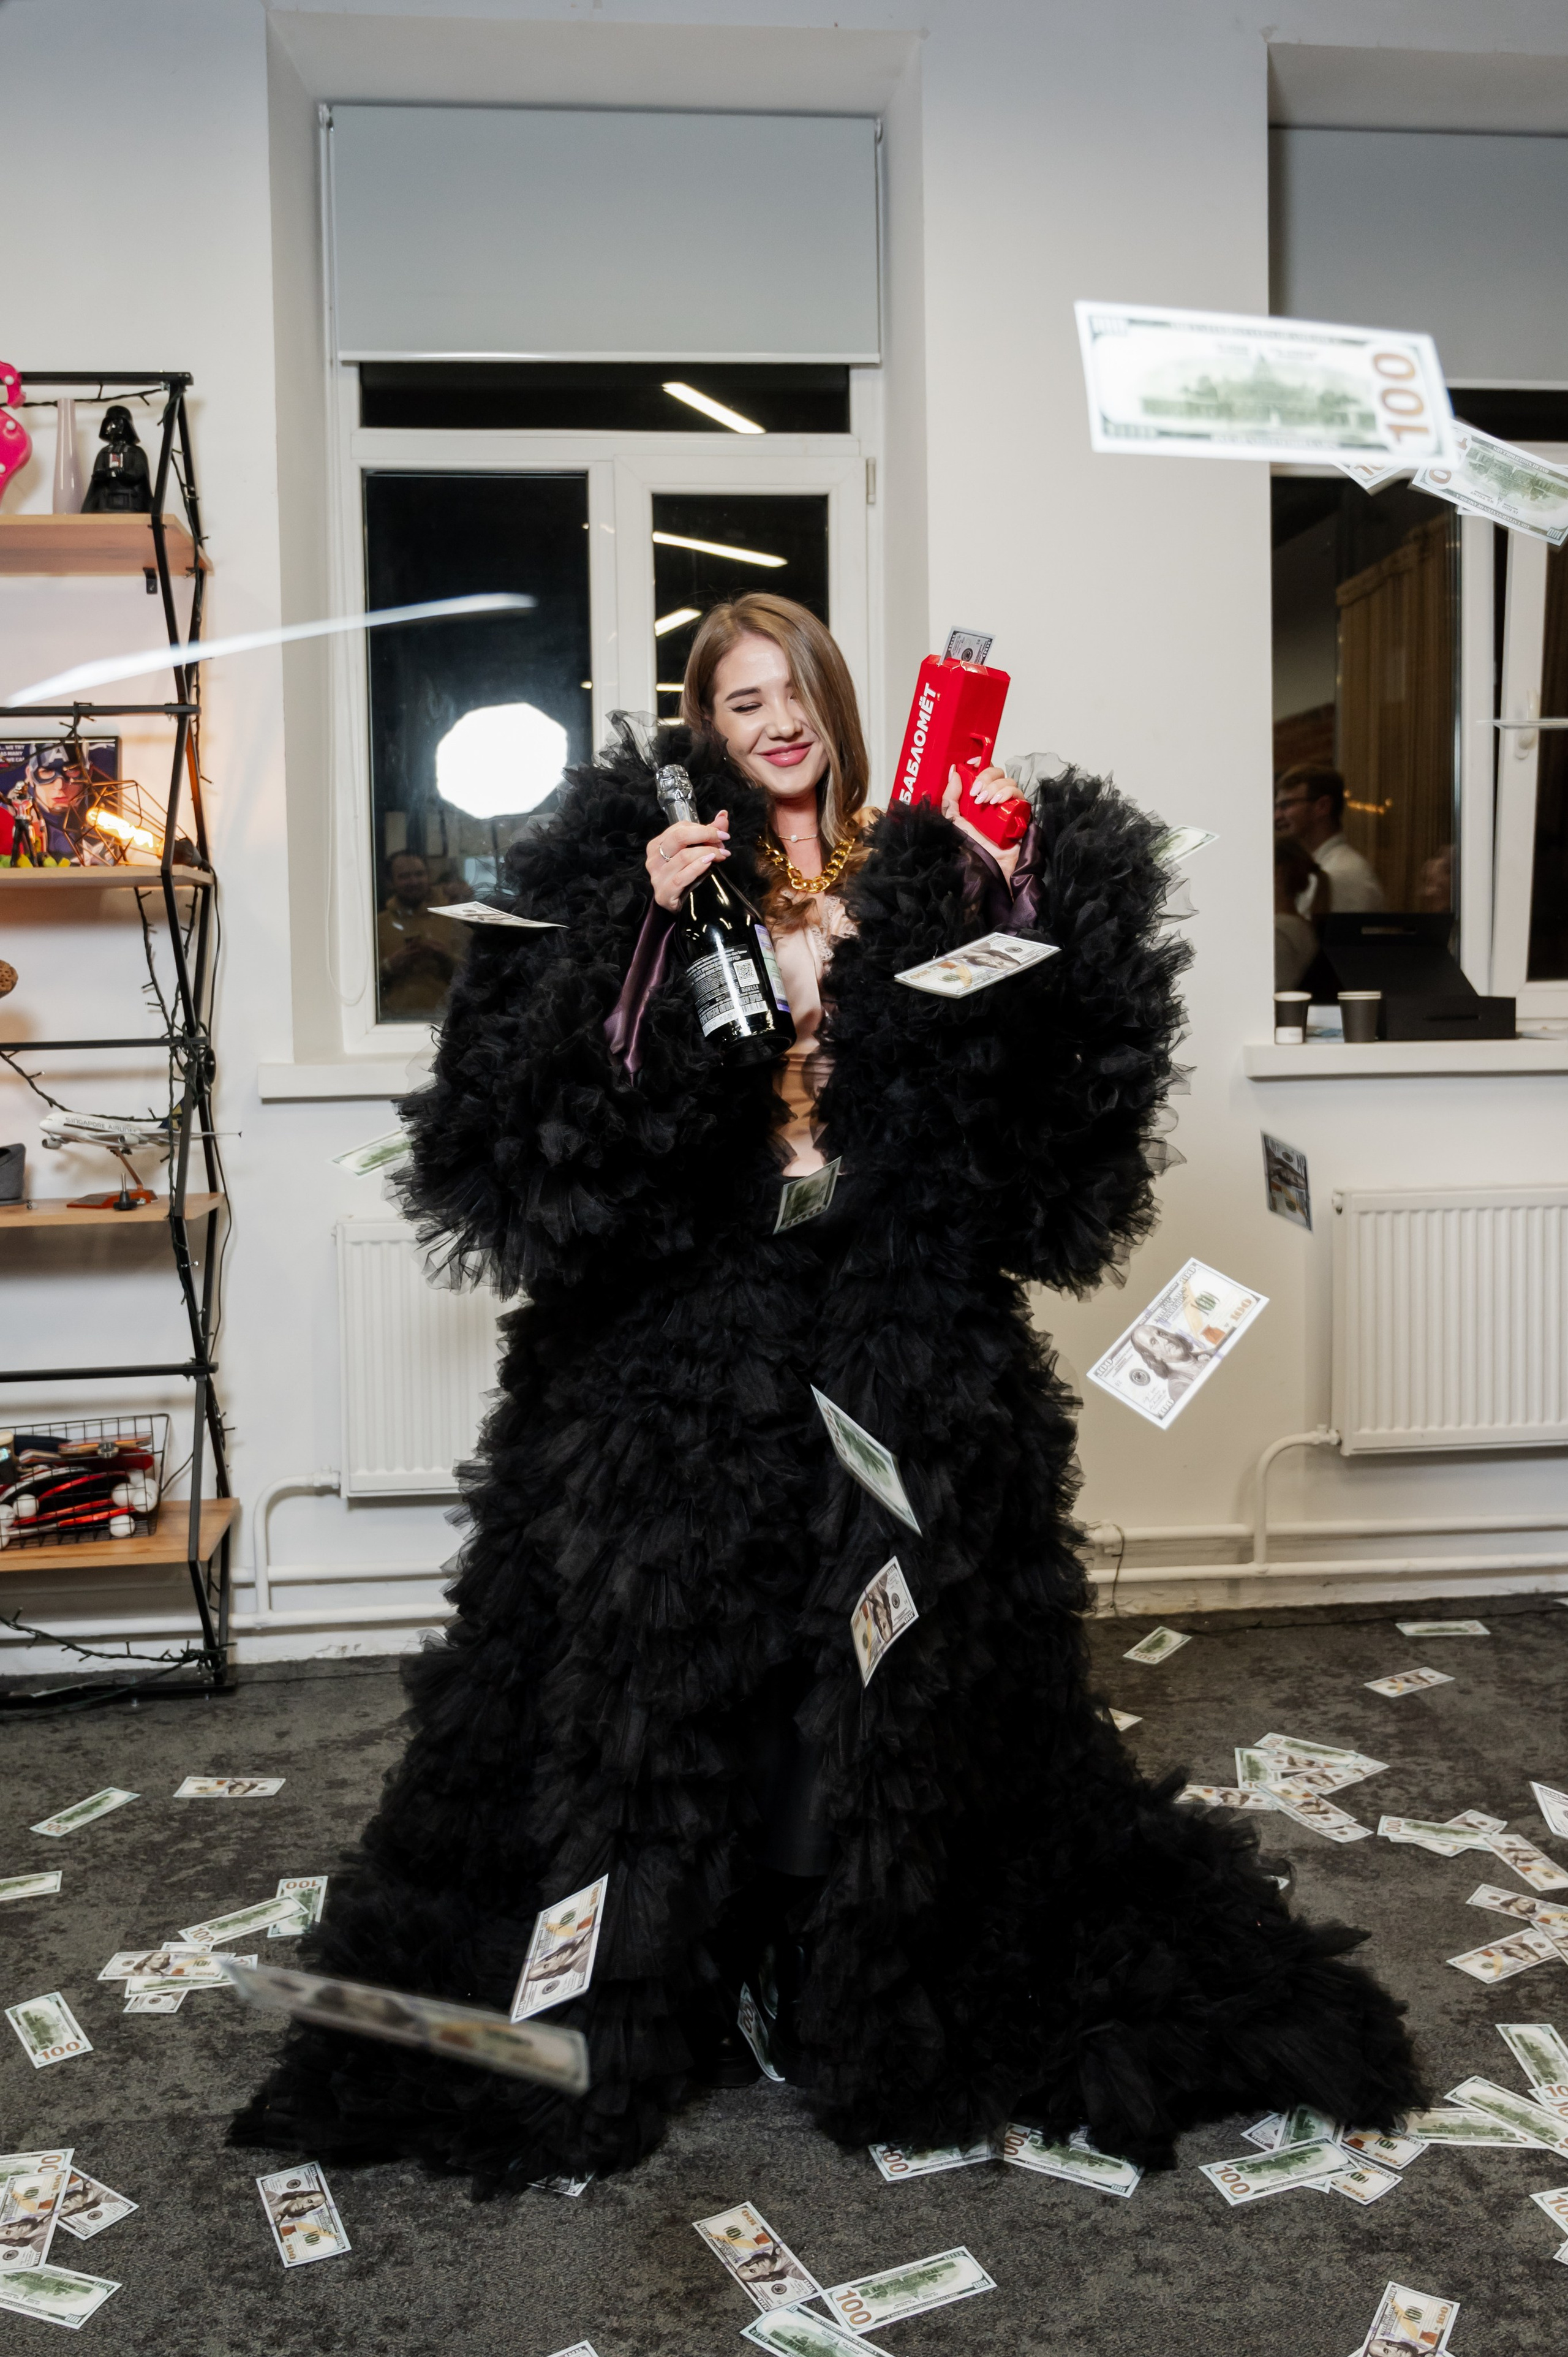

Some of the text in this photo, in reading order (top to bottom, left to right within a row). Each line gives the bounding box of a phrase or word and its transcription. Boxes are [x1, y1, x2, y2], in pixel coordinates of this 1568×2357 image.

[1371, 352, 1430, 446] 100
[899, 682, 937, 805] БАБЛОМЁТ
[66, 1117, 106, 1129] SINGAPORE
[286, 1880, 318, 1889] 100
[40, 2042, 80, 2060] 100
[1545, 2085, 1568, 2097] 10
[1004, 2129, 1029, 2155] 100
[38, 2155, 62, 2173] 00
[1215, 2166, 1250, 2195] 100
[1547, 2196, 1568, 2223] 10
[835, 2290, 872, 2325] 100
